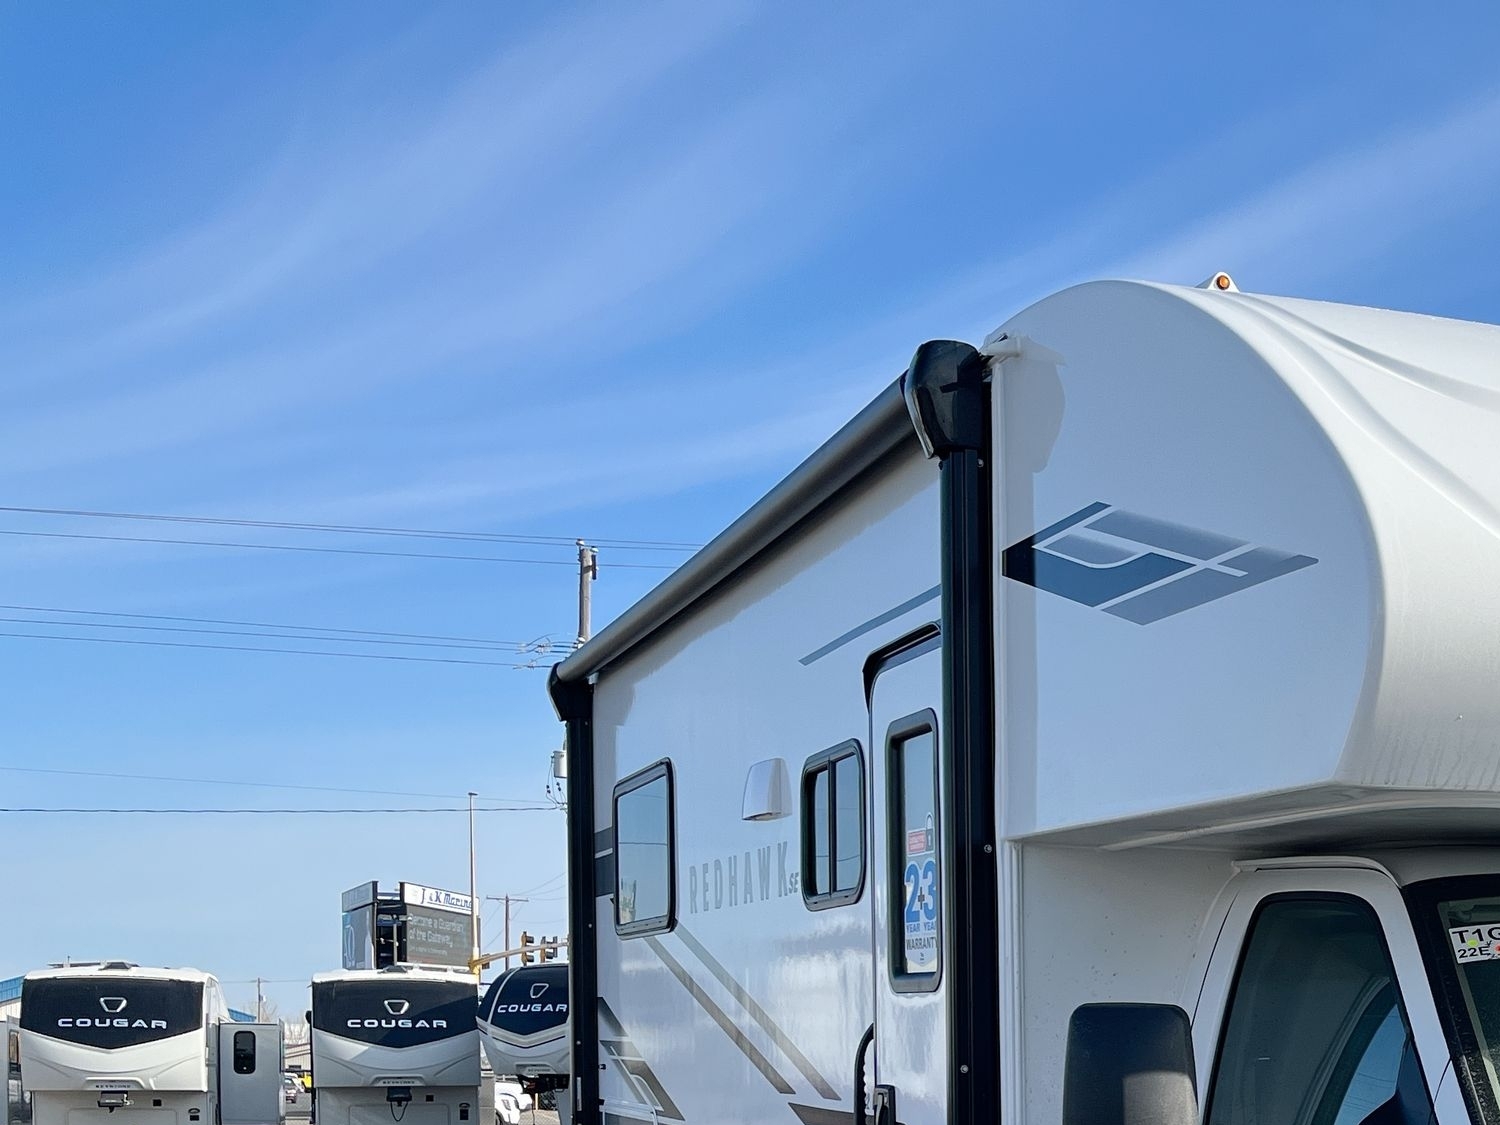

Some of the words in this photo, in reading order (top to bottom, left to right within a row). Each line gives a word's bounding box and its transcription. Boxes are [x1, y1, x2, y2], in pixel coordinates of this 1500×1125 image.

[689, 841, 788, 914] REDHAWK
[1457, 946, 1490, 959] 22E
[497, 1003, 568, 1013] COUGAR
[57, 1018, 168, 1029] COUGAR
[347, 1019, 447, 1029] COUGAR
